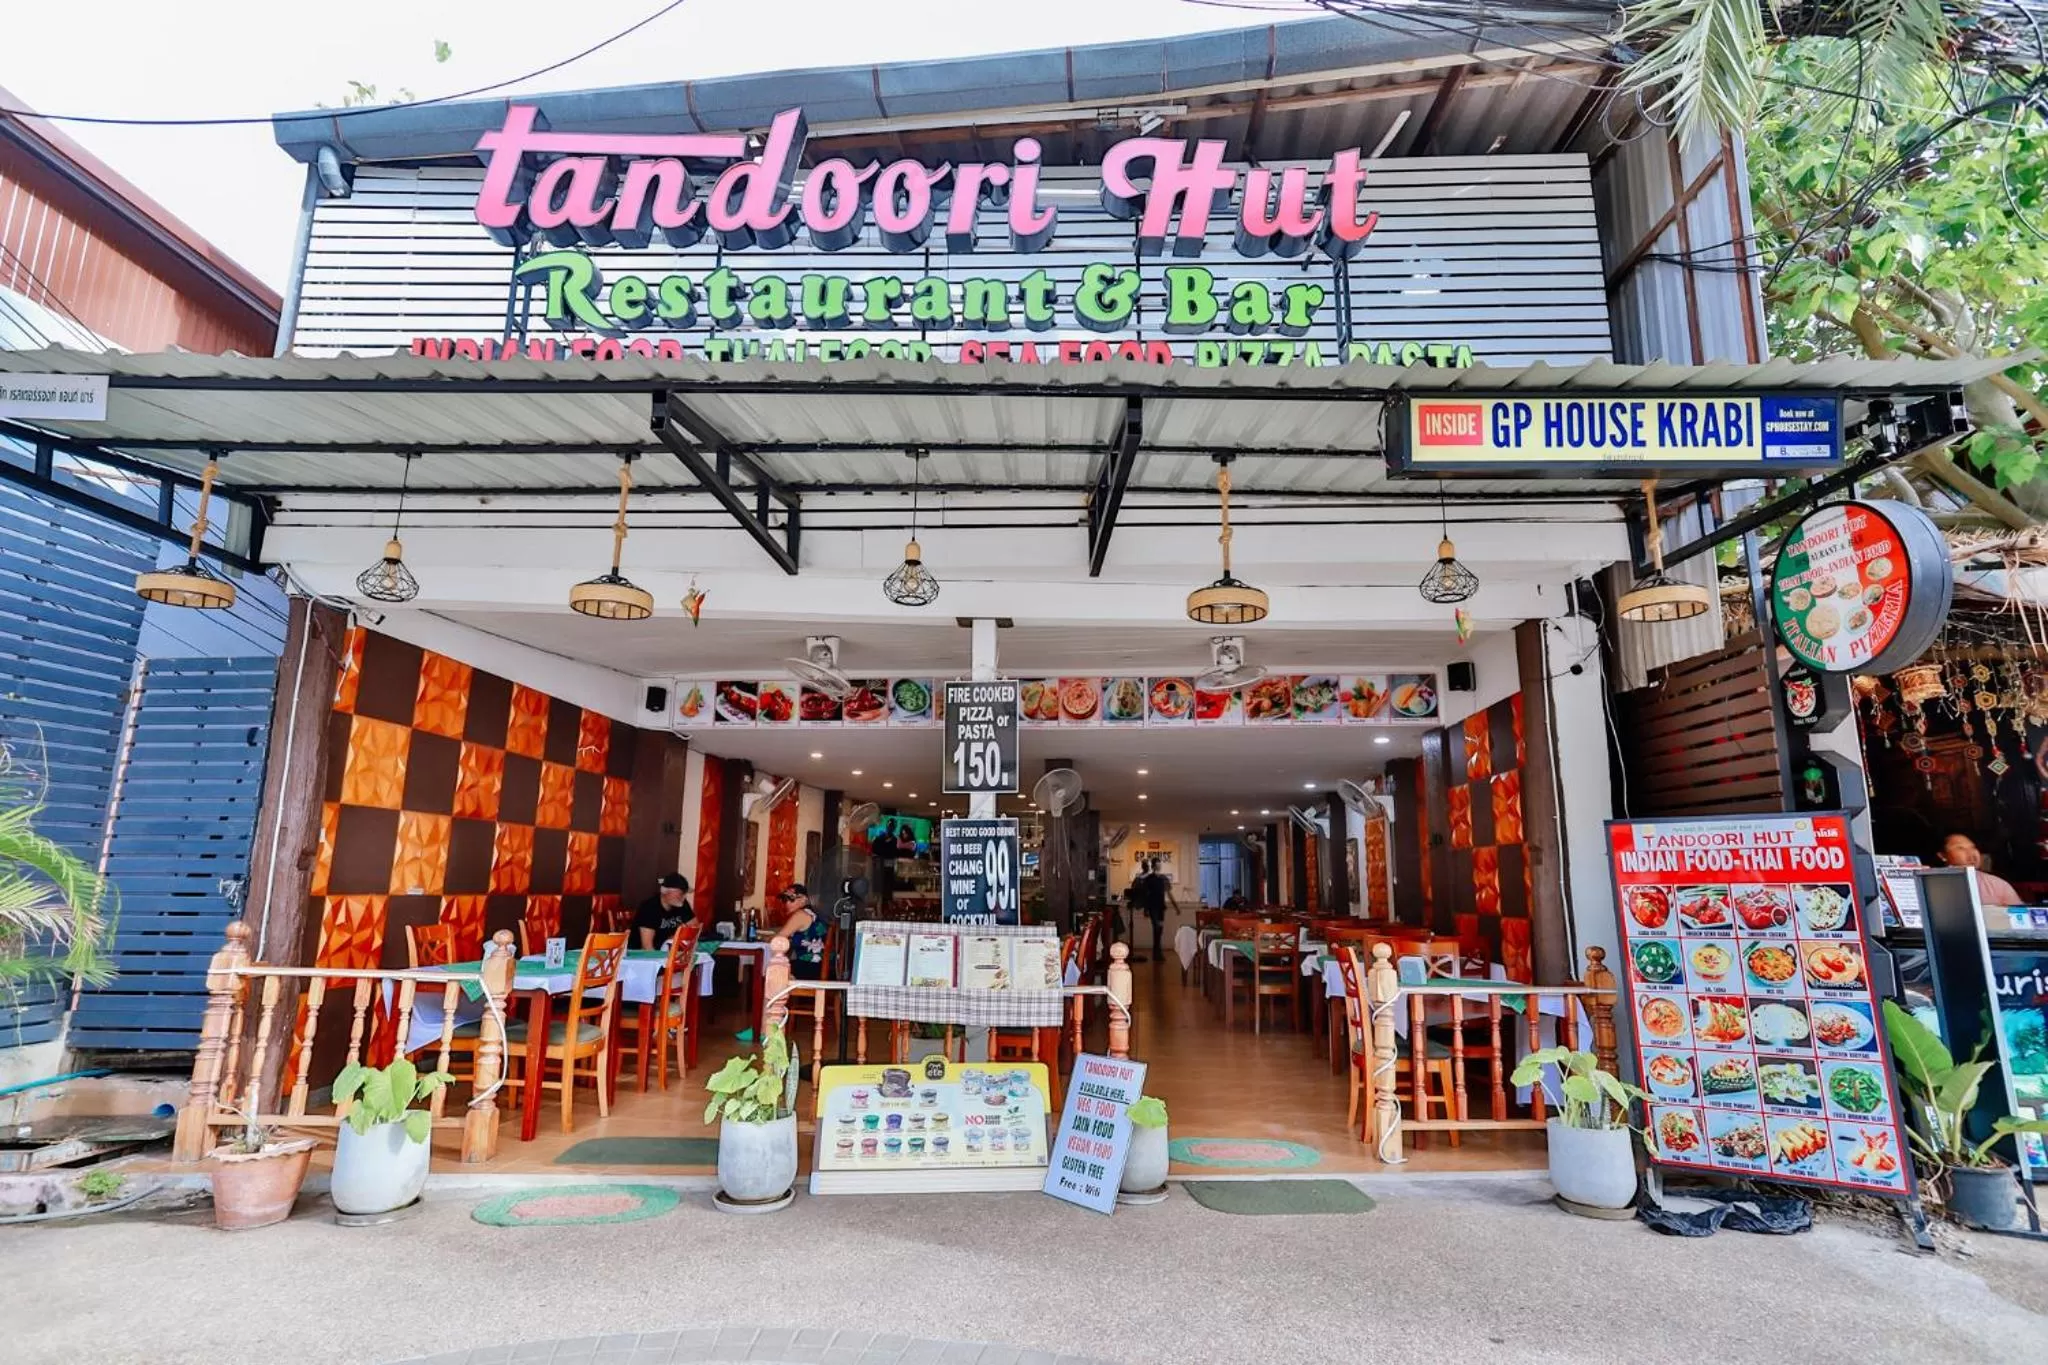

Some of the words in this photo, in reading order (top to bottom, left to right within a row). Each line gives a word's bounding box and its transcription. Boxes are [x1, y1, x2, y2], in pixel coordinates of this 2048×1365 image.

[1100, 137, 1380, 257] Hut
[515, 249, 1057, 335] Restaurant
[1074, 261, 1142, 332] &
[1163, 266, 1325, 335] Bar
[1425, 413, 1477, 436] INSIDE
[1491, 402, 1533, 448] GP
[1544, 402, 1646, 448] HOUSE
[1657, 402, 1754, 448] KRABI
[948, 687, 971, 703] FIRE
[973, 686, 1015, 702] COOKED
[959, 706, 993, 722] PIZZA
[997, 714, 1009, 727] or
[958, 724, 995, 740] PASTA
[945, 827, 961, 838] BEST
[961, 827, 978, 838] FOOD
[979, 827, 996, 837] GOOD
[996, 827, 1016, 837] DRINK
[1642, 833, 1744, 848] TANDOORI
[1754, 831, 1795, 846] HUT
[950, 844, 963, 855] BIG
[964, 843, 982, 855] BEER
[949, 860, 983, 876] CHANG
[1620, 850, 1678, 873] INDIAN
[1685, 848, 1783, 872] FOOD-THAI
[1791, 846, 1845, 871] FOOD
[950, 880, 975, 895] WINE
[957, 898, 968, 911] or
[1095, 1101, 1116, 1118] FOOD
[965, 1114, 984, 1125] NO
[1092, 1119, 1115, 1139] FOOD
[1093, 1142, 1113, 1160] FOOD
[1061, 1155, 1087, 1176] GLUTEN
[1087, 1161, 1105, 1180] FREE
[1059, 1176, 1077, 1191] Free
